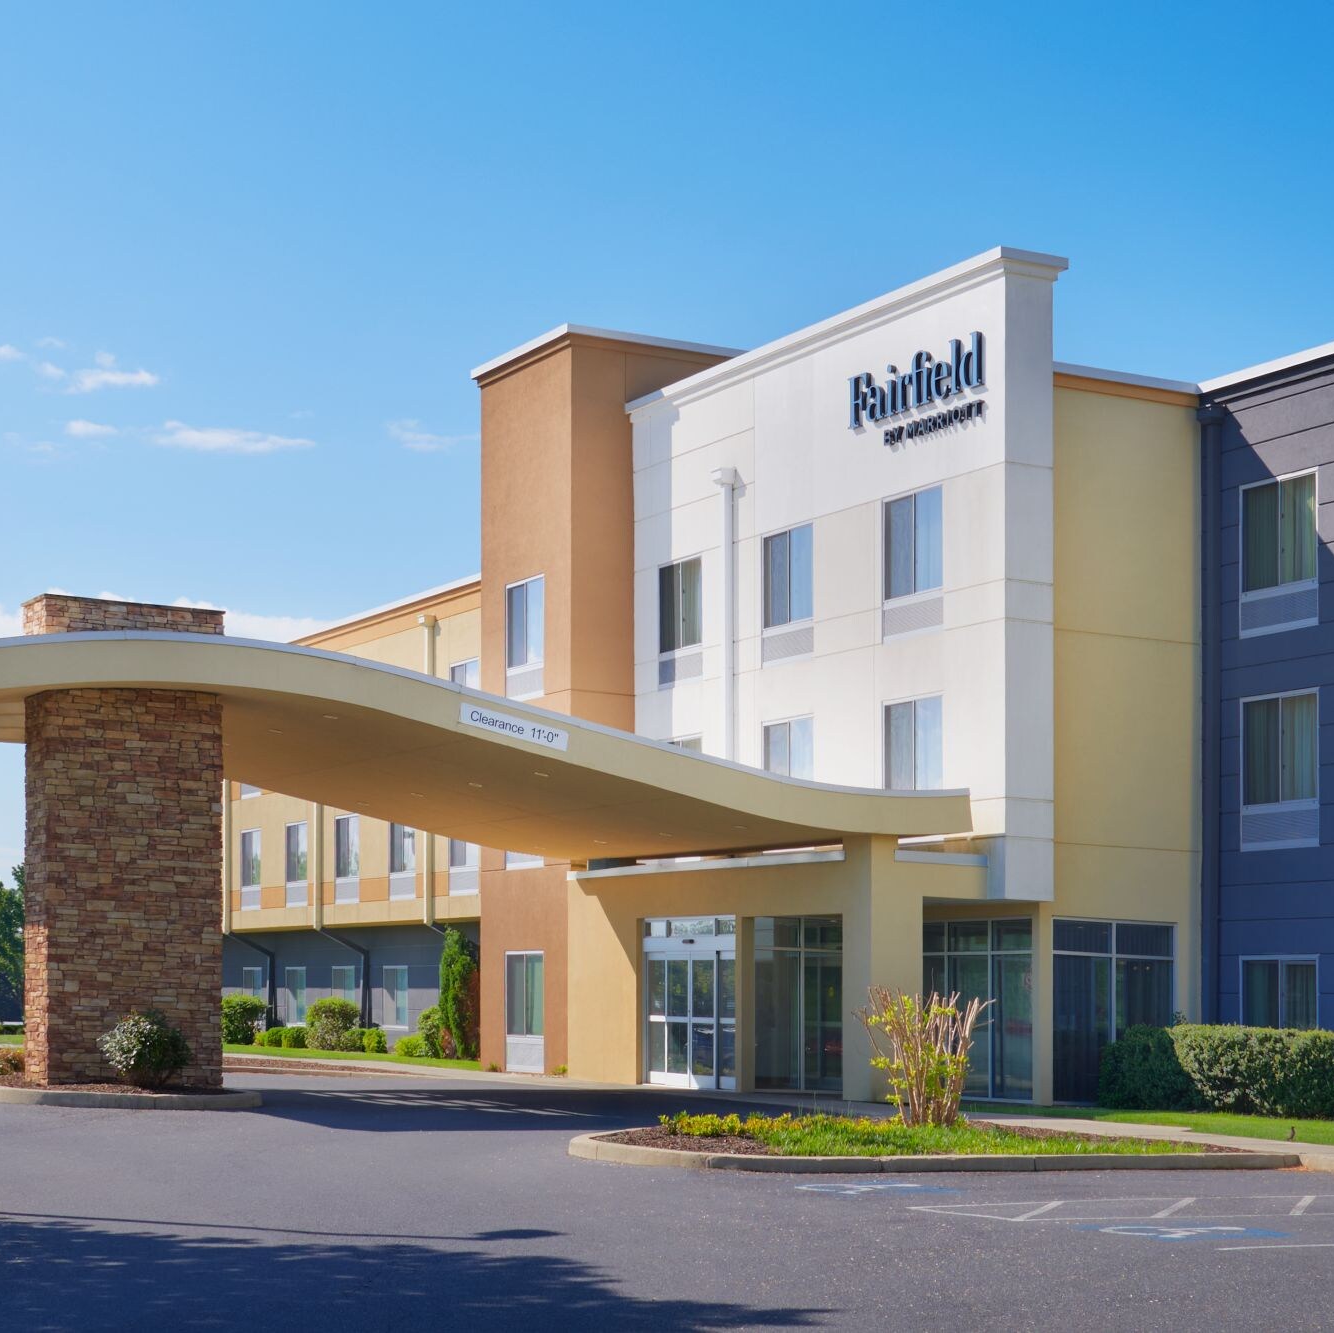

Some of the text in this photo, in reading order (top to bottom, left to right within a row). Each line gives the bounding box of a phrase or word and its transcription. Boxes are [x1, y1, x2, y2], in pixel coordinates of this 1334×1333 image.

[847, 331, 983, 430] Fairfield
[883, 399, 985, 446] BY MARRIOTT
[470, 710, 525, 735] Clearance
